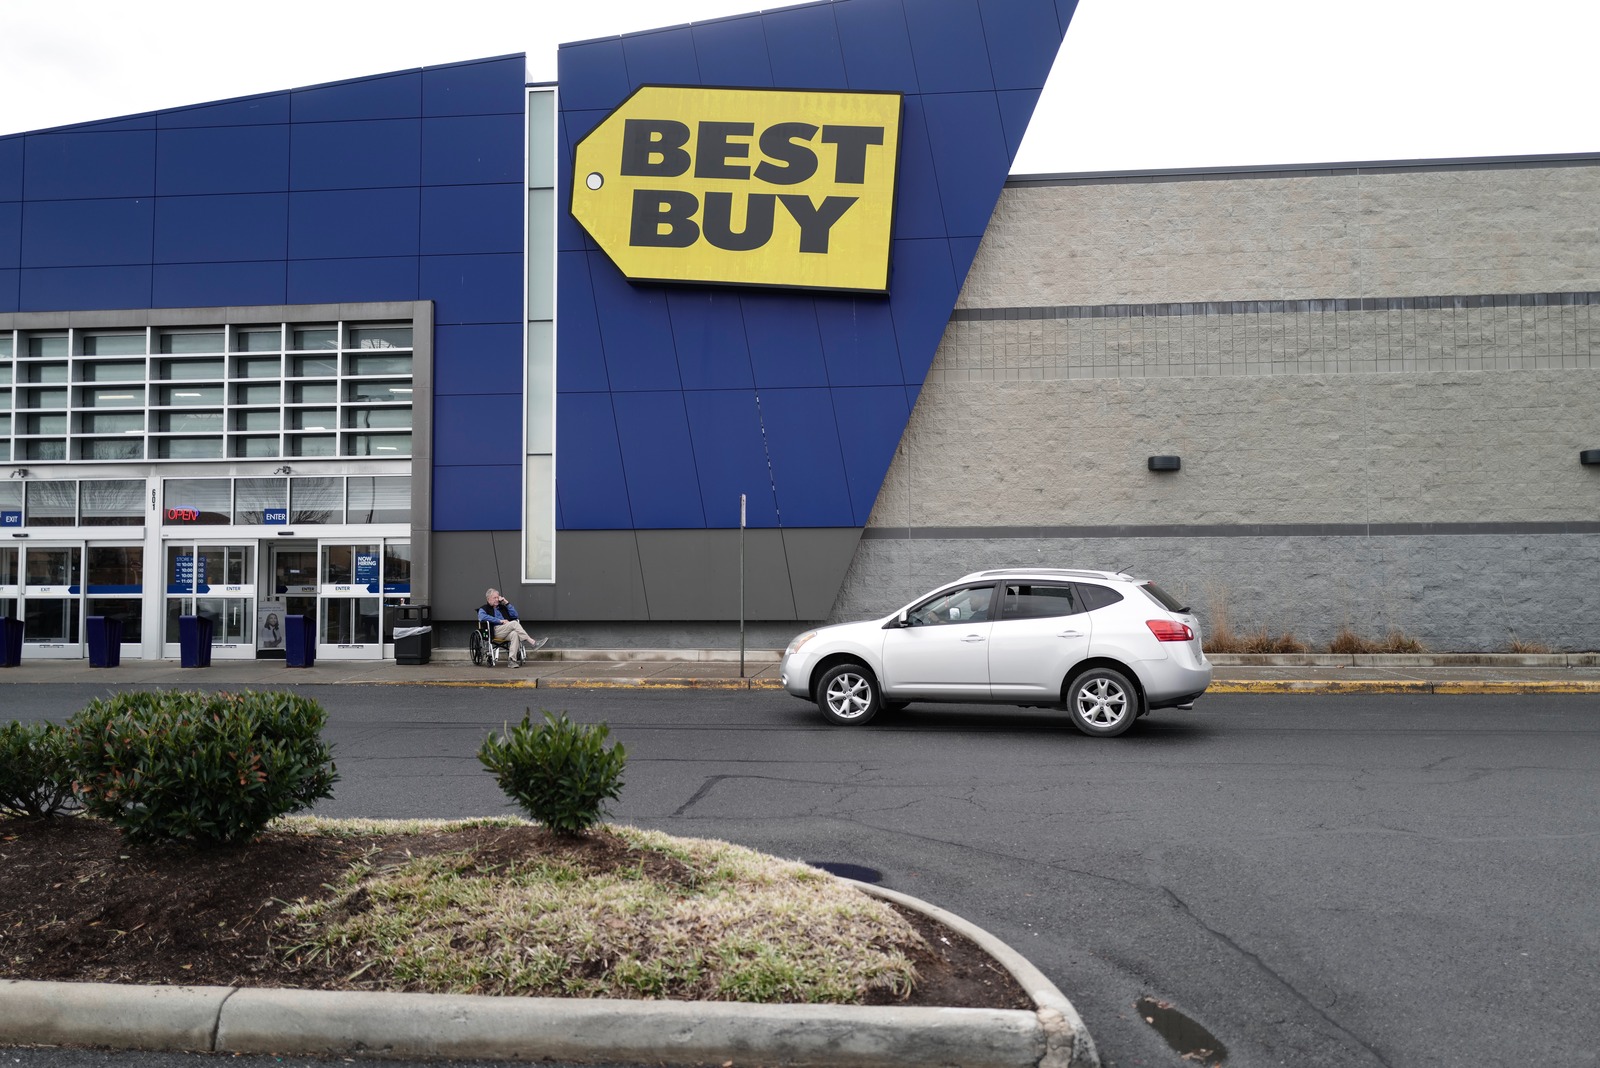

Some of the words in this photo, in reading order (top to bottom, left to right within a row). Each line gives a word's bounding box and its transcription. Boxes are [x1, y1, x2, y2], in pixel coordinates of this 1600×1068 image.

[620, 119, 885, 185] BEST
[629, 189, 860, 254] BUY
[5, 515, 18, 523] EXIT
[168, 508, 197, 520] OPEN
[266, 513, 286, 521] ENTER
